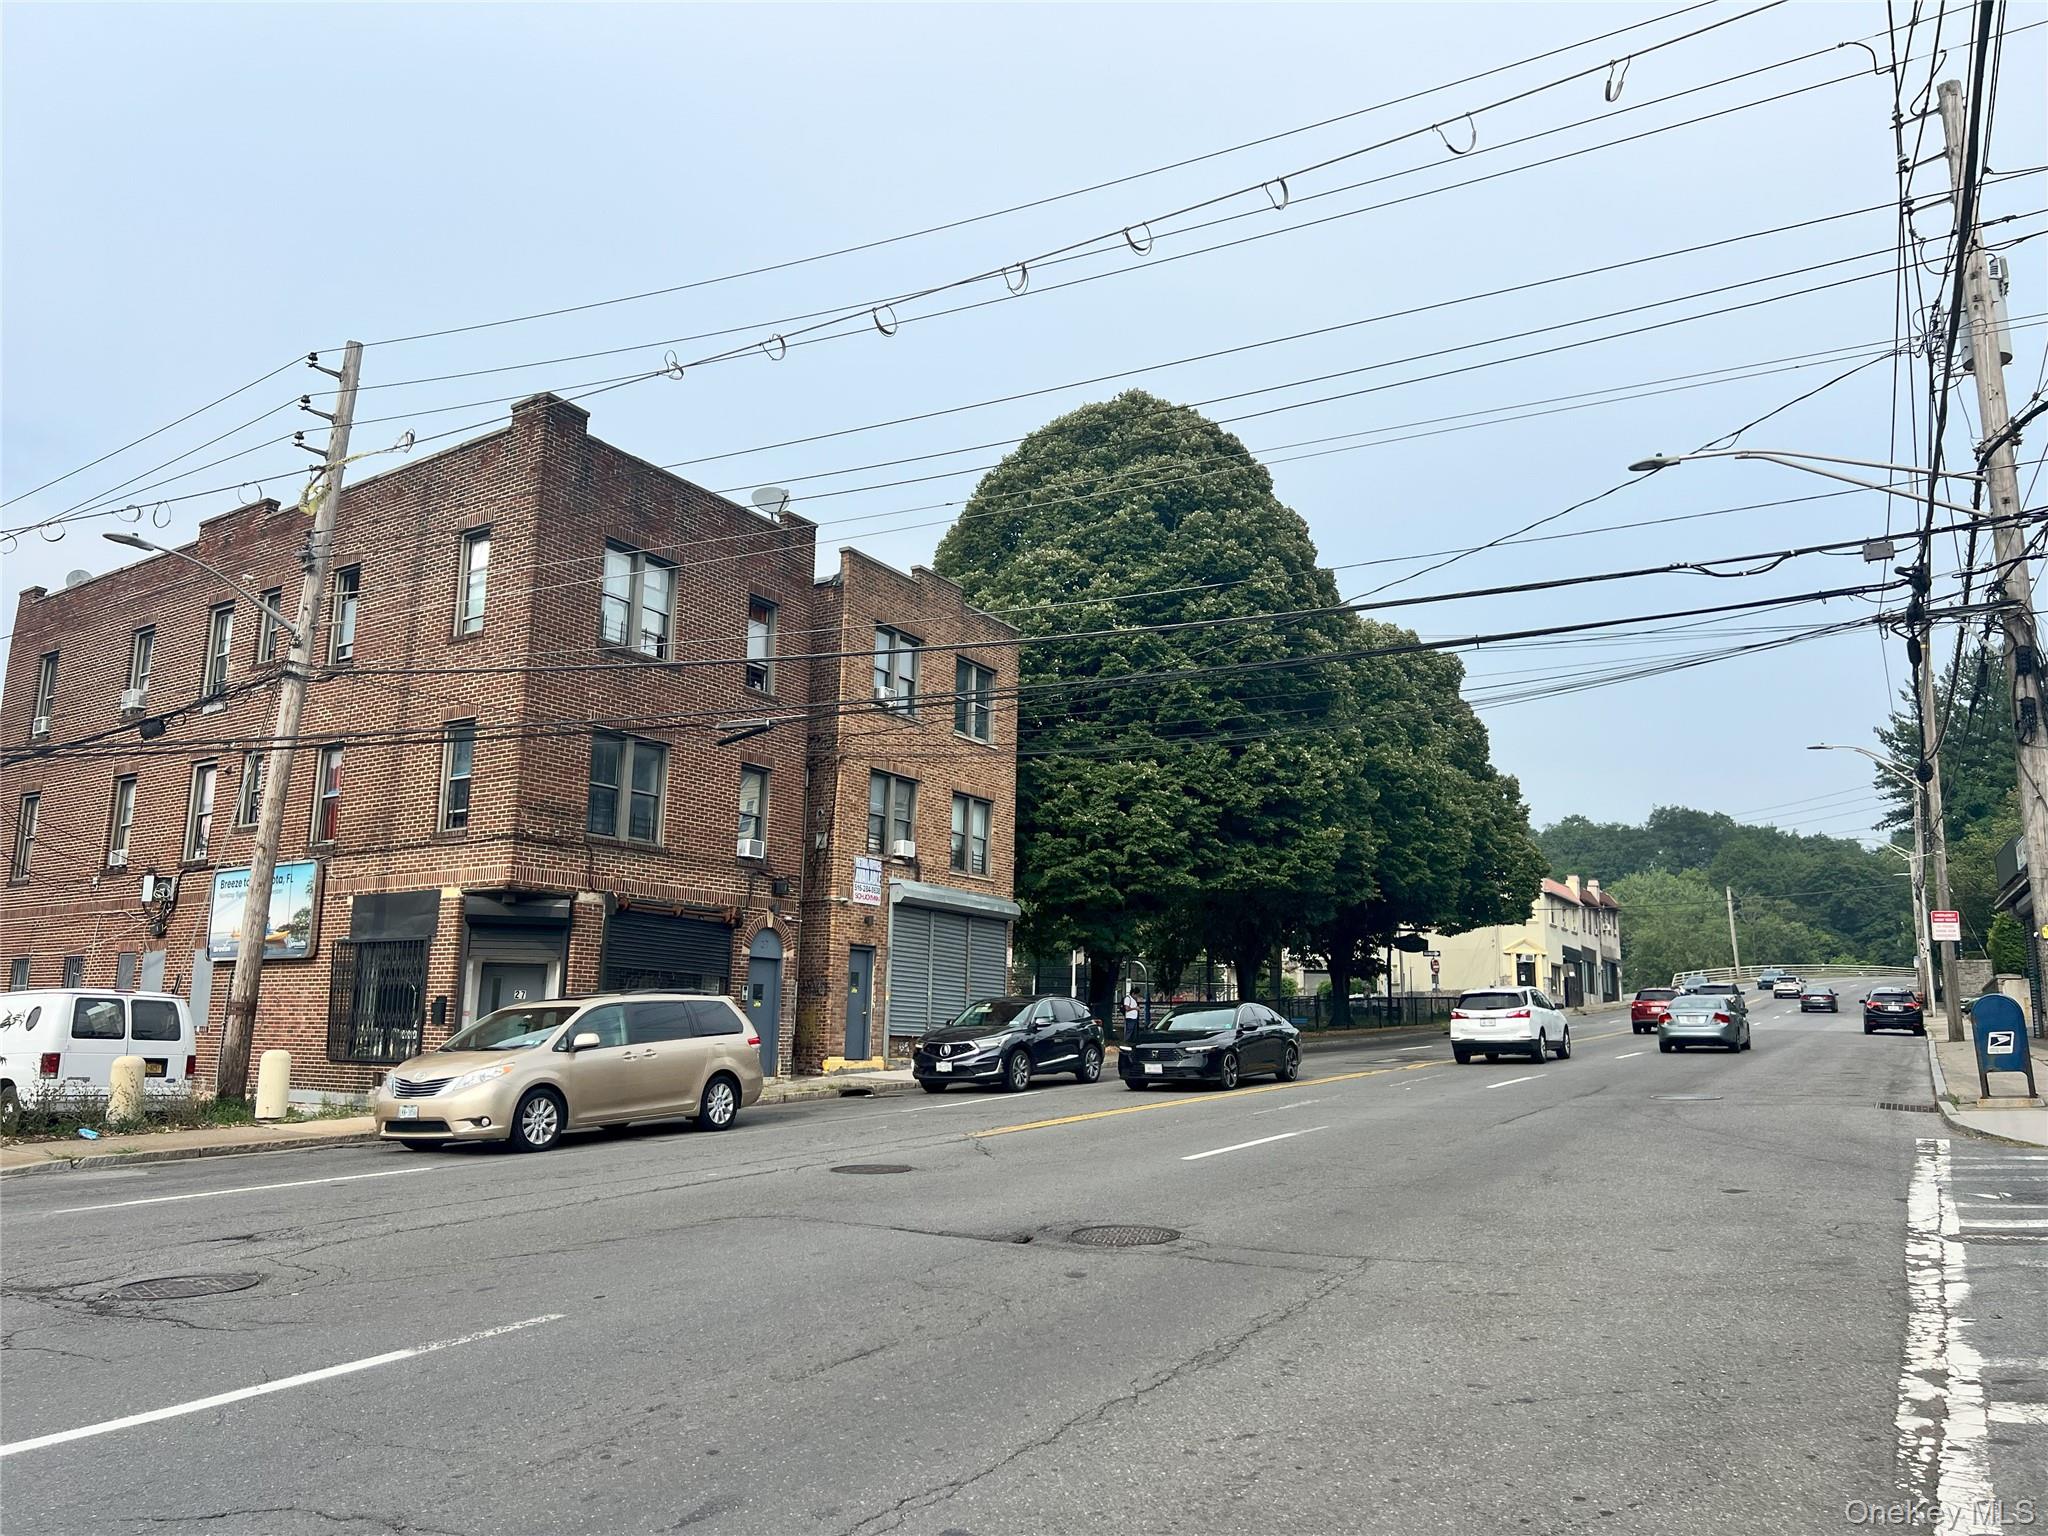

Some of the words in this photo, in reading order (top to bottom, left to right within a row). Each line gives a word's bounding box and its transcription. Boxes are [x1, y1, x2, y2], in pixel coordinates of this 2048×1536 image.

[220, 880, 242, 890] Breeze
[286, 873, 294, 884] FL
[515, 990, 526, 999] 27
